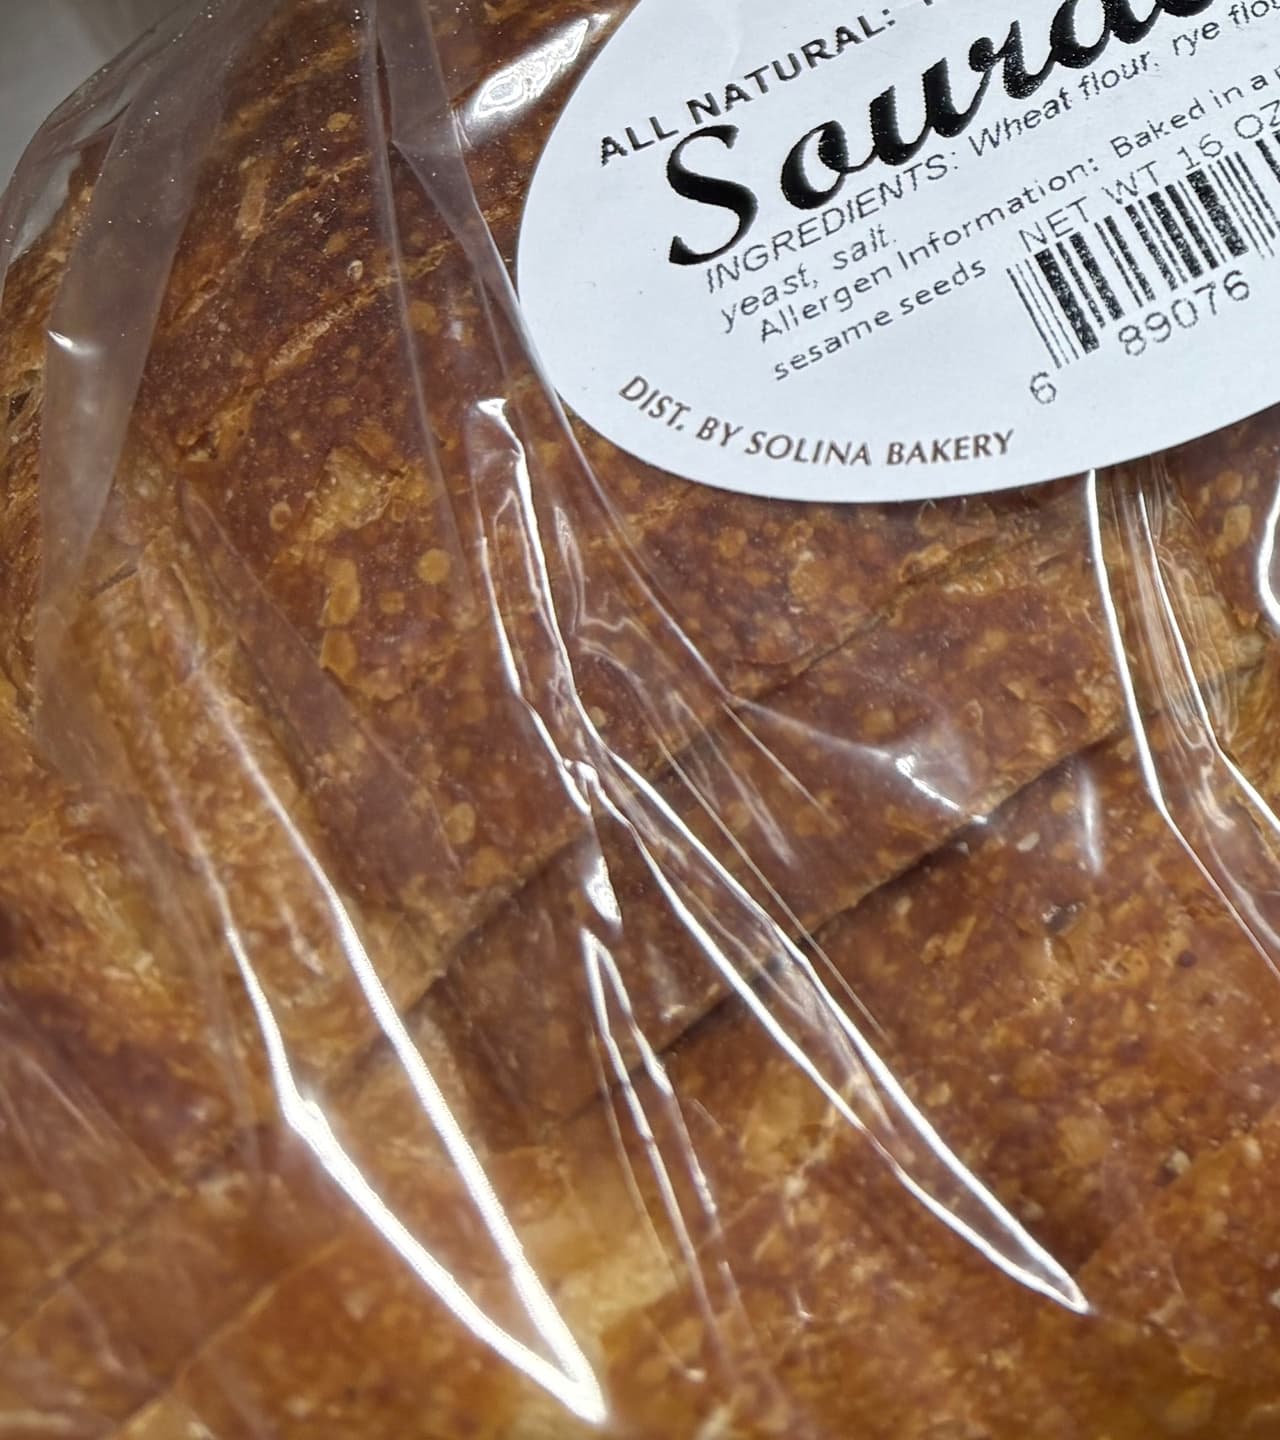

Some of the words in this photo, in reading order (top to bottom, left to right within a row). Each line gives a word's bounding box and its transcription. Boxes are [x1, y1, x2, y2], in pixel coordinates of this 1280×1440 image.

[600, 115, 679, 167] ALL
[685, 7, 897, 125] NATURAL:
[706, 151, 960, 295] INGREDIENTS:
[968, 87, 1073, 157] Wheat
[1171, 19, 1221, 58] rye
[760, 263, 893, 345] Allergen
[896, 156, 1101, 271] Information:
[1109, 97, 1206, 160] Baked
[1207, 85, 1245, 110] in
[1249, 72, 1270, 92] a
[1017, 195, 1092, 253] NET
[1100, 160, 1162, 206] WT
[1175, 132, 1224, 172] 16
[720, 261, 820, 335] yeast,
[774, 309, 895, 382] sesame
[898, 256, 989, 317] seeds
[1028, 371, 1058, 406] 6
[1117, 269, 1252, 358] 89076
[618, 374, 692, 432] DIST.
[695, 415, 745, 449] BY
[744, 429, 872, 467] SOLINA
[885, 427, 1016, 467] BAKERY
